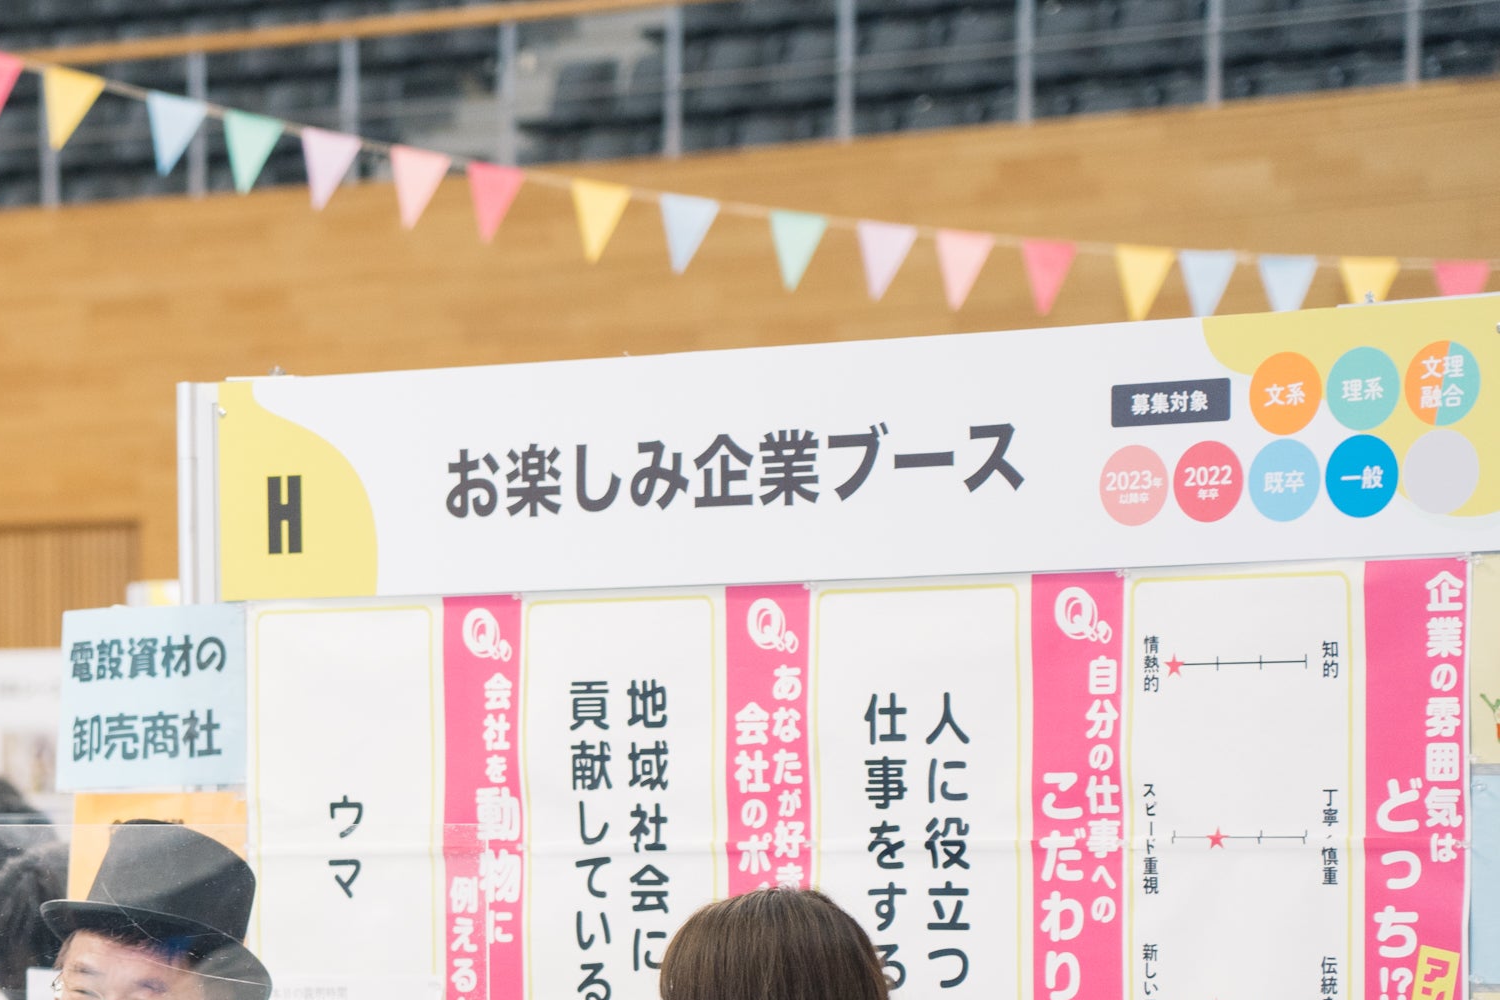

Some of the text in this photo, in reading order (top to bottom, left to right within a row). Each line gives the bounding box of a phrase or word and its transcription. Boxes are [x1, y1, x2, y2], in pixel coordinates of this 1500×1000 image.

[1263, 381, 1306, 408] 文系
[1341, 377, 1385, 402] 理系
[1420, 354, 1465, 380] 文理
[1130, 389, 1210, 416] 募集対象
[1420, 384, 1465, 409] 融合
[445, 422, 1026, 519] お楽しみ企業ブース
[1184, 464, 1233, 488] 2022
[1263, 469, 1306, 494] 既卒
[1340, 464, 1384, 491] 一般
[267, 474, 303, 555] H
[69, 635, 227, 683] 電設資材の
[1143, 634, 1160, 693] 情熱的
[1321, 640, 1339, 680] 知的
[72, 708, 223, 765] 卸売商社
[1425, 570, 1464, 864] 企業の雰囲気は
[475, 672, 522, 944] 会社を動物に
[734, 700, 773, 891] 会社のポ
[1085, 655, 1121, 924] 自分の仕事への
[328, 794, 364, 899] ウマ
[628, 679, 670, 972] 地域社会に
[925, 692, 972, 989] 人に役立つ
[1142, 783, 1160, 896] スピード重視
